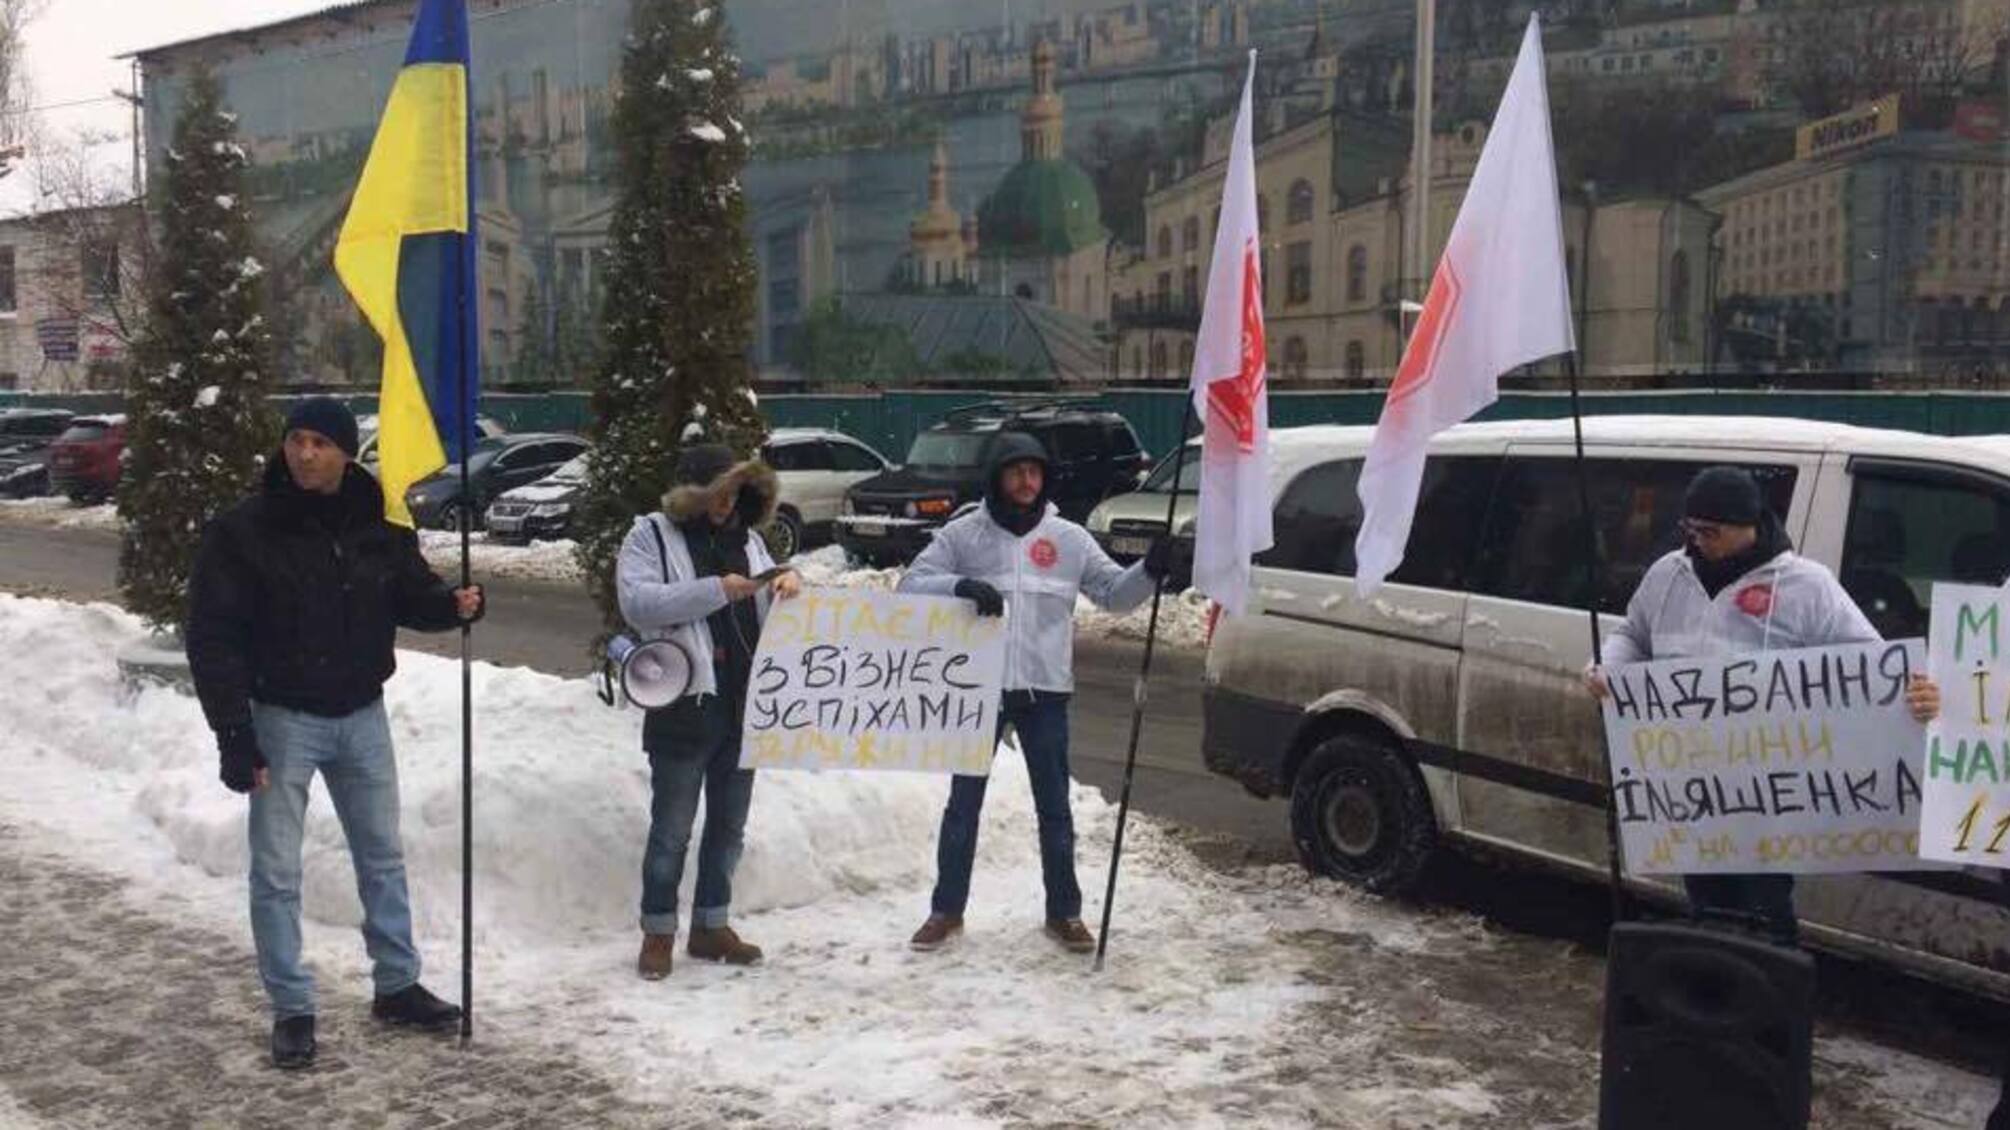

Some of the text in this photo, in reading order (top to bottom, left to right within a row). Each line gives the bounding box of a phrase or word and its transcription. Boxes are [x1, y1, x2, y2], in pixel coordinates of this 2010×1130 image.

[1810, 114, 1880, 148] Nikon
[1606, 644, 1911, 720] НАДБАННЯ
[751, 693, 984, 735] УСПІХАМИ
[1632, 719, 1834, 771] РОДИНИ
[1614, 757, 1924, 822] ІЛЬЯШЕНКА
